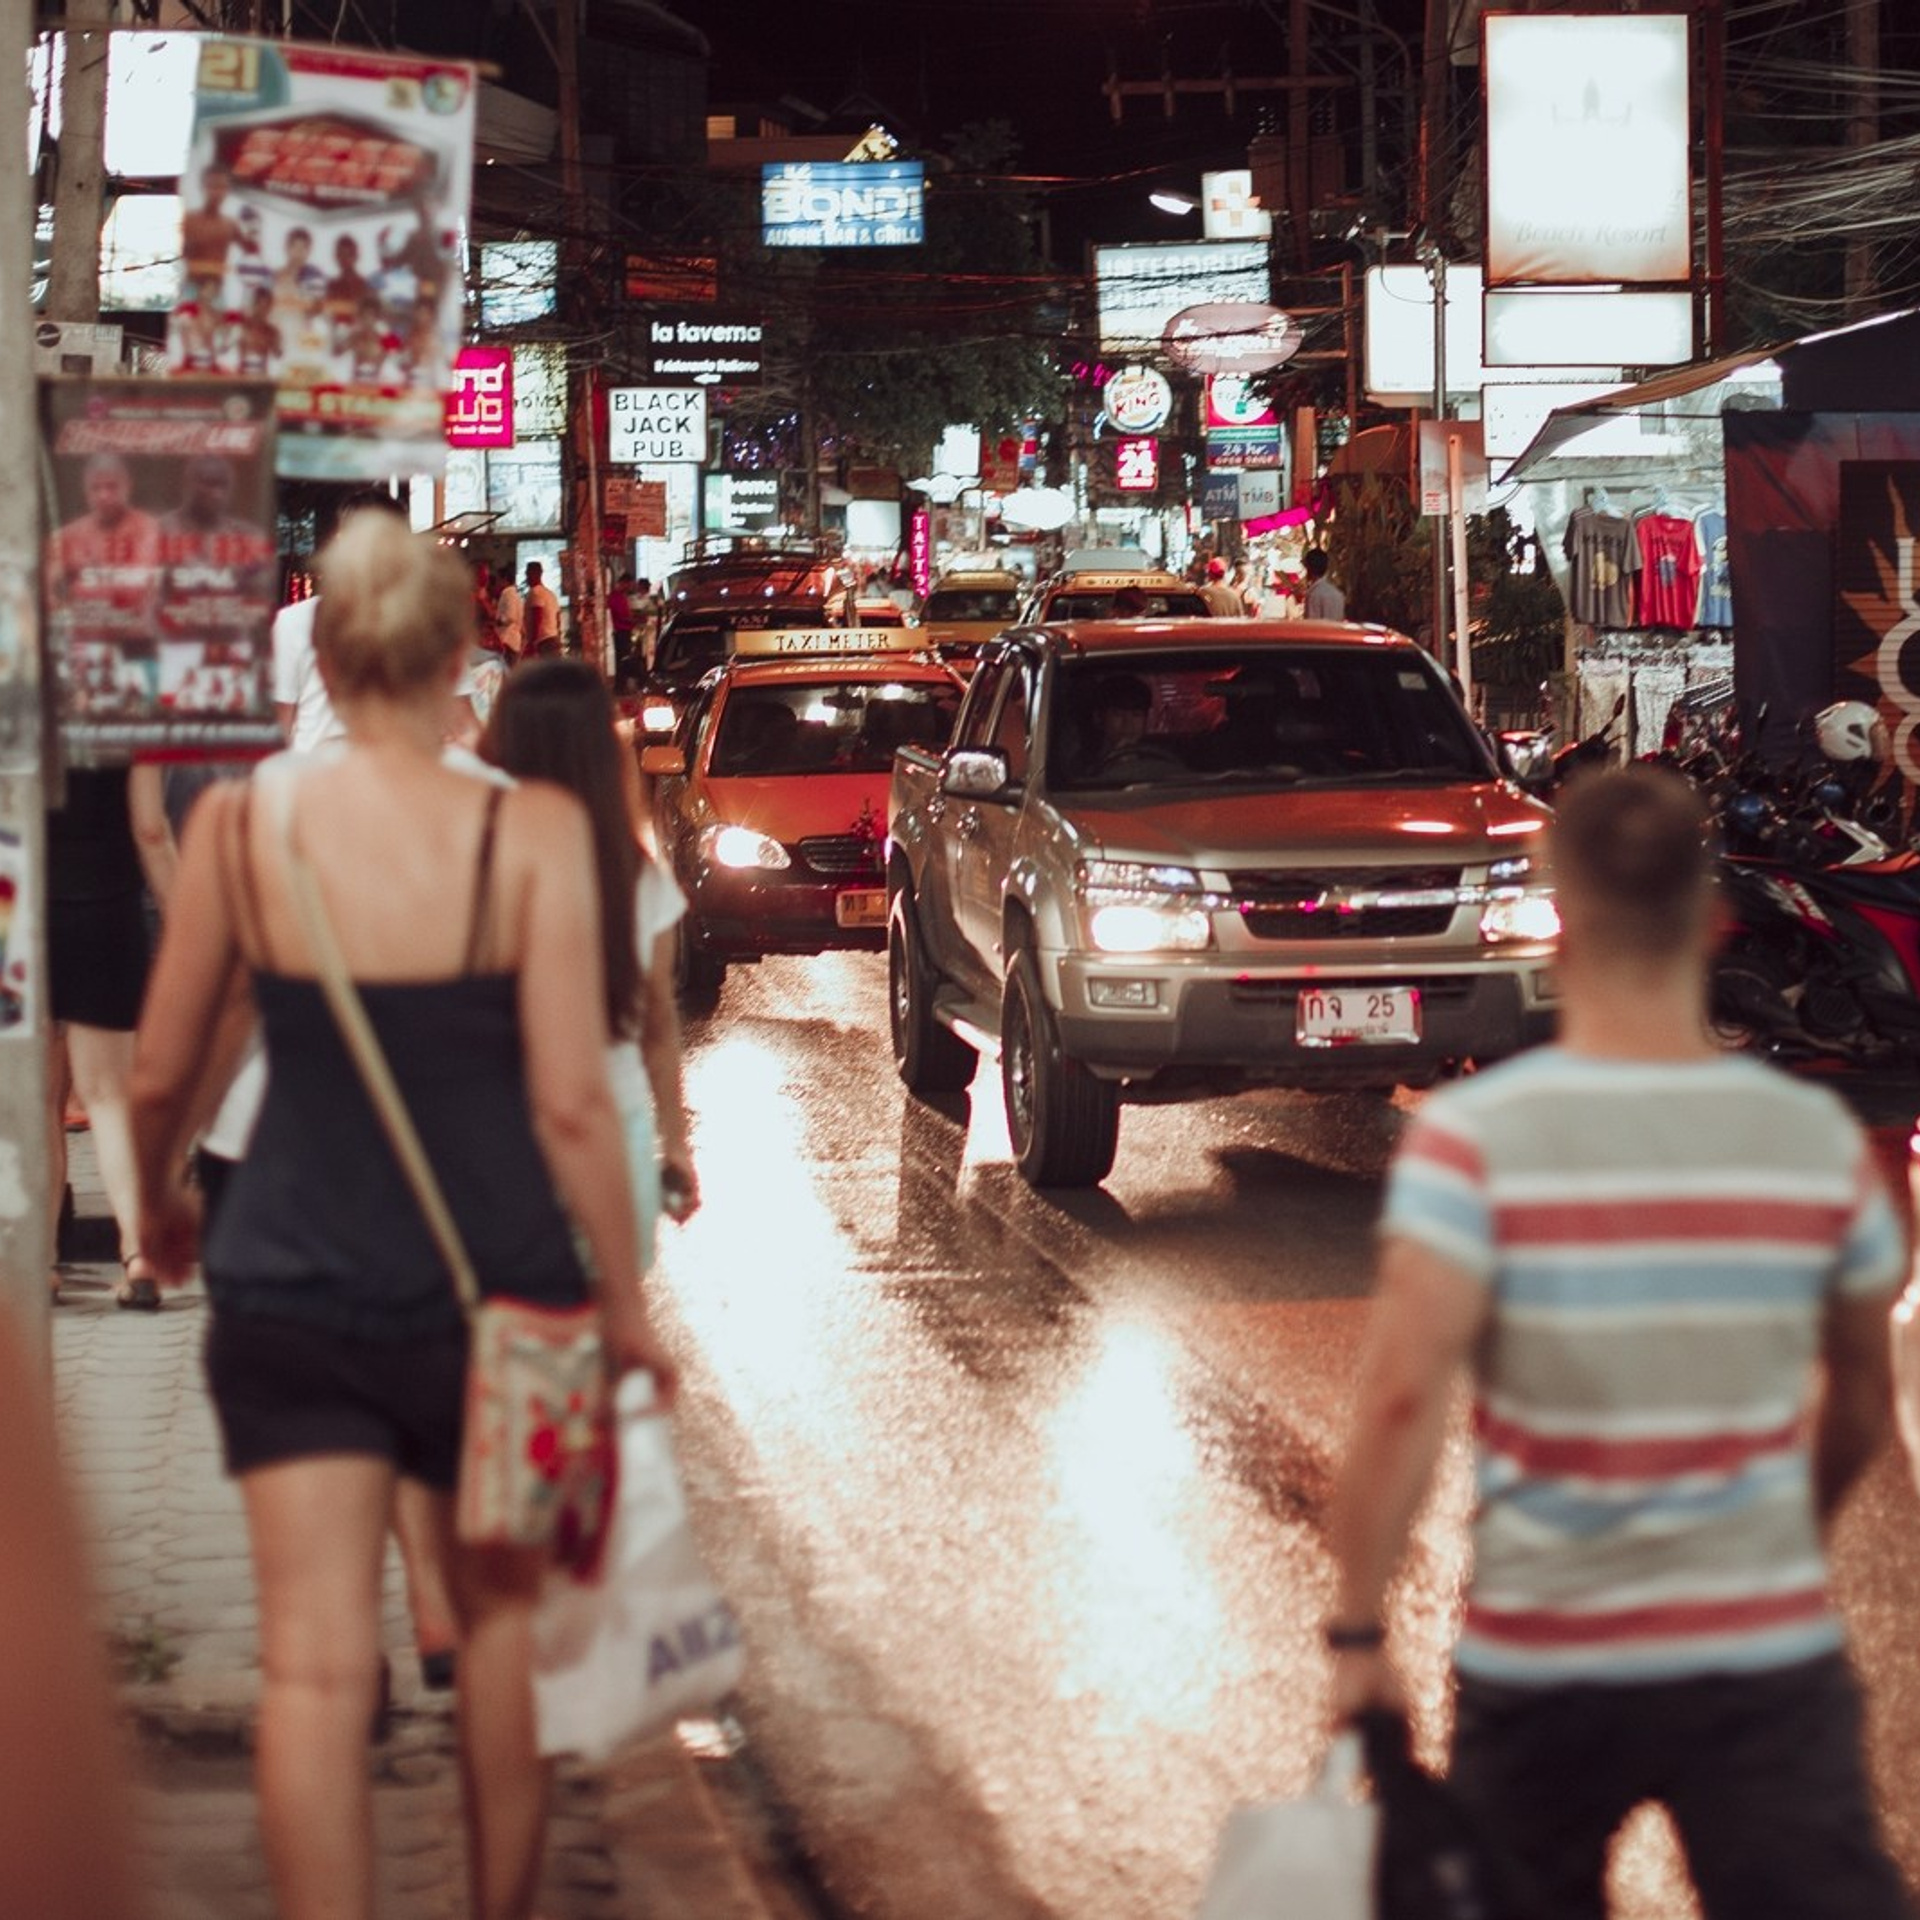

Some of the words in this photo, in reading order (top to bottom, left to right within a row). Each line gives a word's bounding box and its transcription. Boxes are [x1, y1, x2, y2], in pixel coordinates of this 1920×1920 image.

[201, 42, 259, 91] 21
[874, 225, 921, 244] GRILL
[652, 322, 674, 342] la
[614, 392, 700, 411] BLACK
[624, 416, 691, 433] JACK
[633, 441, 684, 457] PUB
[1222, 443, 1244, 456] 24
[1117, 448, 1156, 478] 24
[1205, 487, 1238, 502] ATM
[1241, 489, 1275, 504] TMB
[729, 615, 769, 626] TAXI
[1367, 994, 1395, 1018] 25
